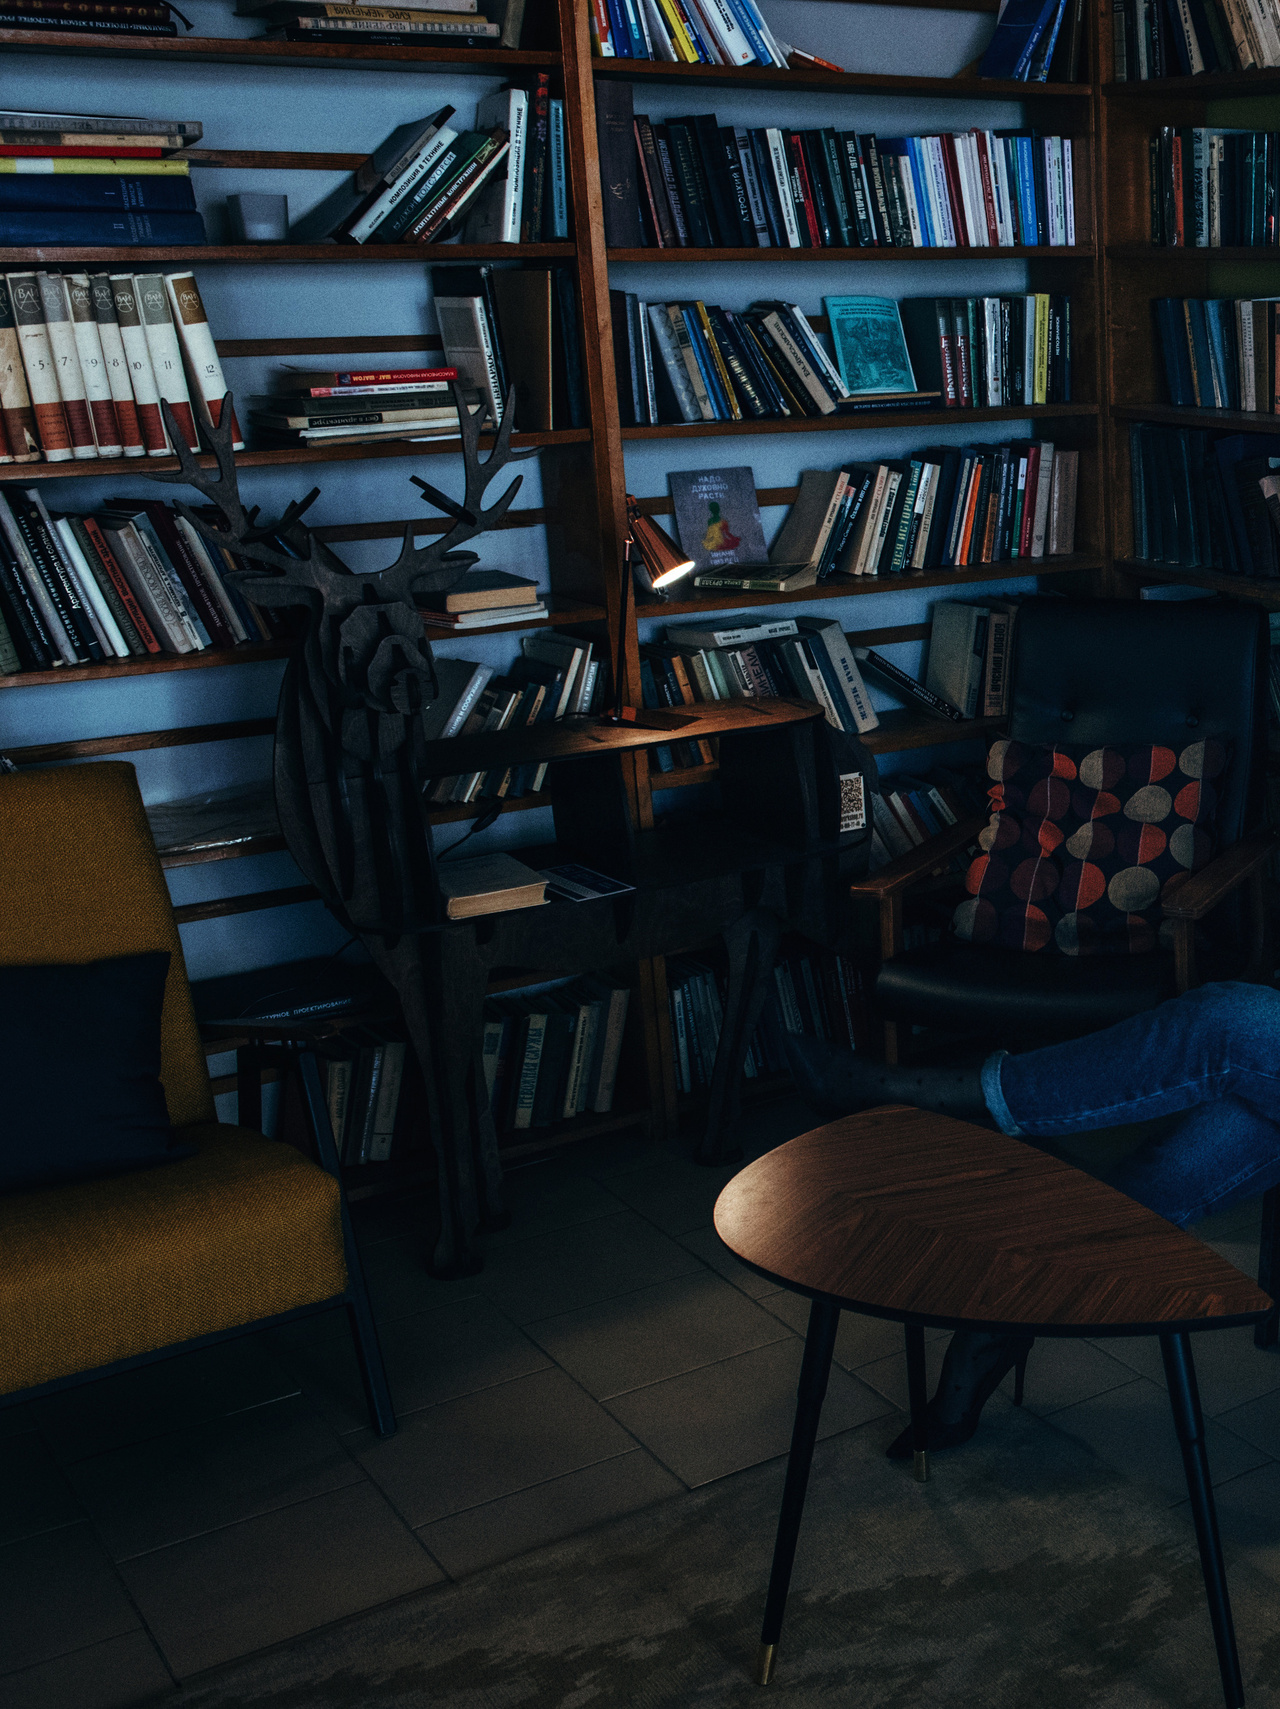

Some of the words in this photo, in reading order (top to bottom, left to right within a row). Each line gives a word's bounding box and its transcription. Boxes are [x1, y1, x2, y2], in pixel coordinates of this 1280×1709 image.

[389, 168, 420, 205] КОМПОЗИЦИЯ
[418, 162, 425, 170] В
[424, 140, 445, 166] ТЕХНИКЕ
[400, 201, 418, 225] ДЖОН
[415, 152, 457, 202] ГОЛСУОРСИ
[412, 195, 448, 236] АРХИТЕКТУРНЫЕ
[447, 162, 478, 197] КОНСТРУКЦИИ
[352, 374, 375, 382] ШАГОМ
[312, 416, 360, 427] архитектуре
[91, 529, 112, 561] ЗДАНИЙ
[53, 560, 81, 610] Архитектура
[109, 561, 131, 597] ВЫСОТНЫХ
[128, 597, 154, 645] КОНСТРУКЦИИ
[994, 623, 1005, 657] БОЕВОЙ
[462, 675, 484, 713] СООРУЖЕНИЯ
[841, 658, 853, 682] ИВАН
[851, 687, 868, 721] МЕЛЕЖ
[992, 658, 1003, 693] ПРИЗЫВ
